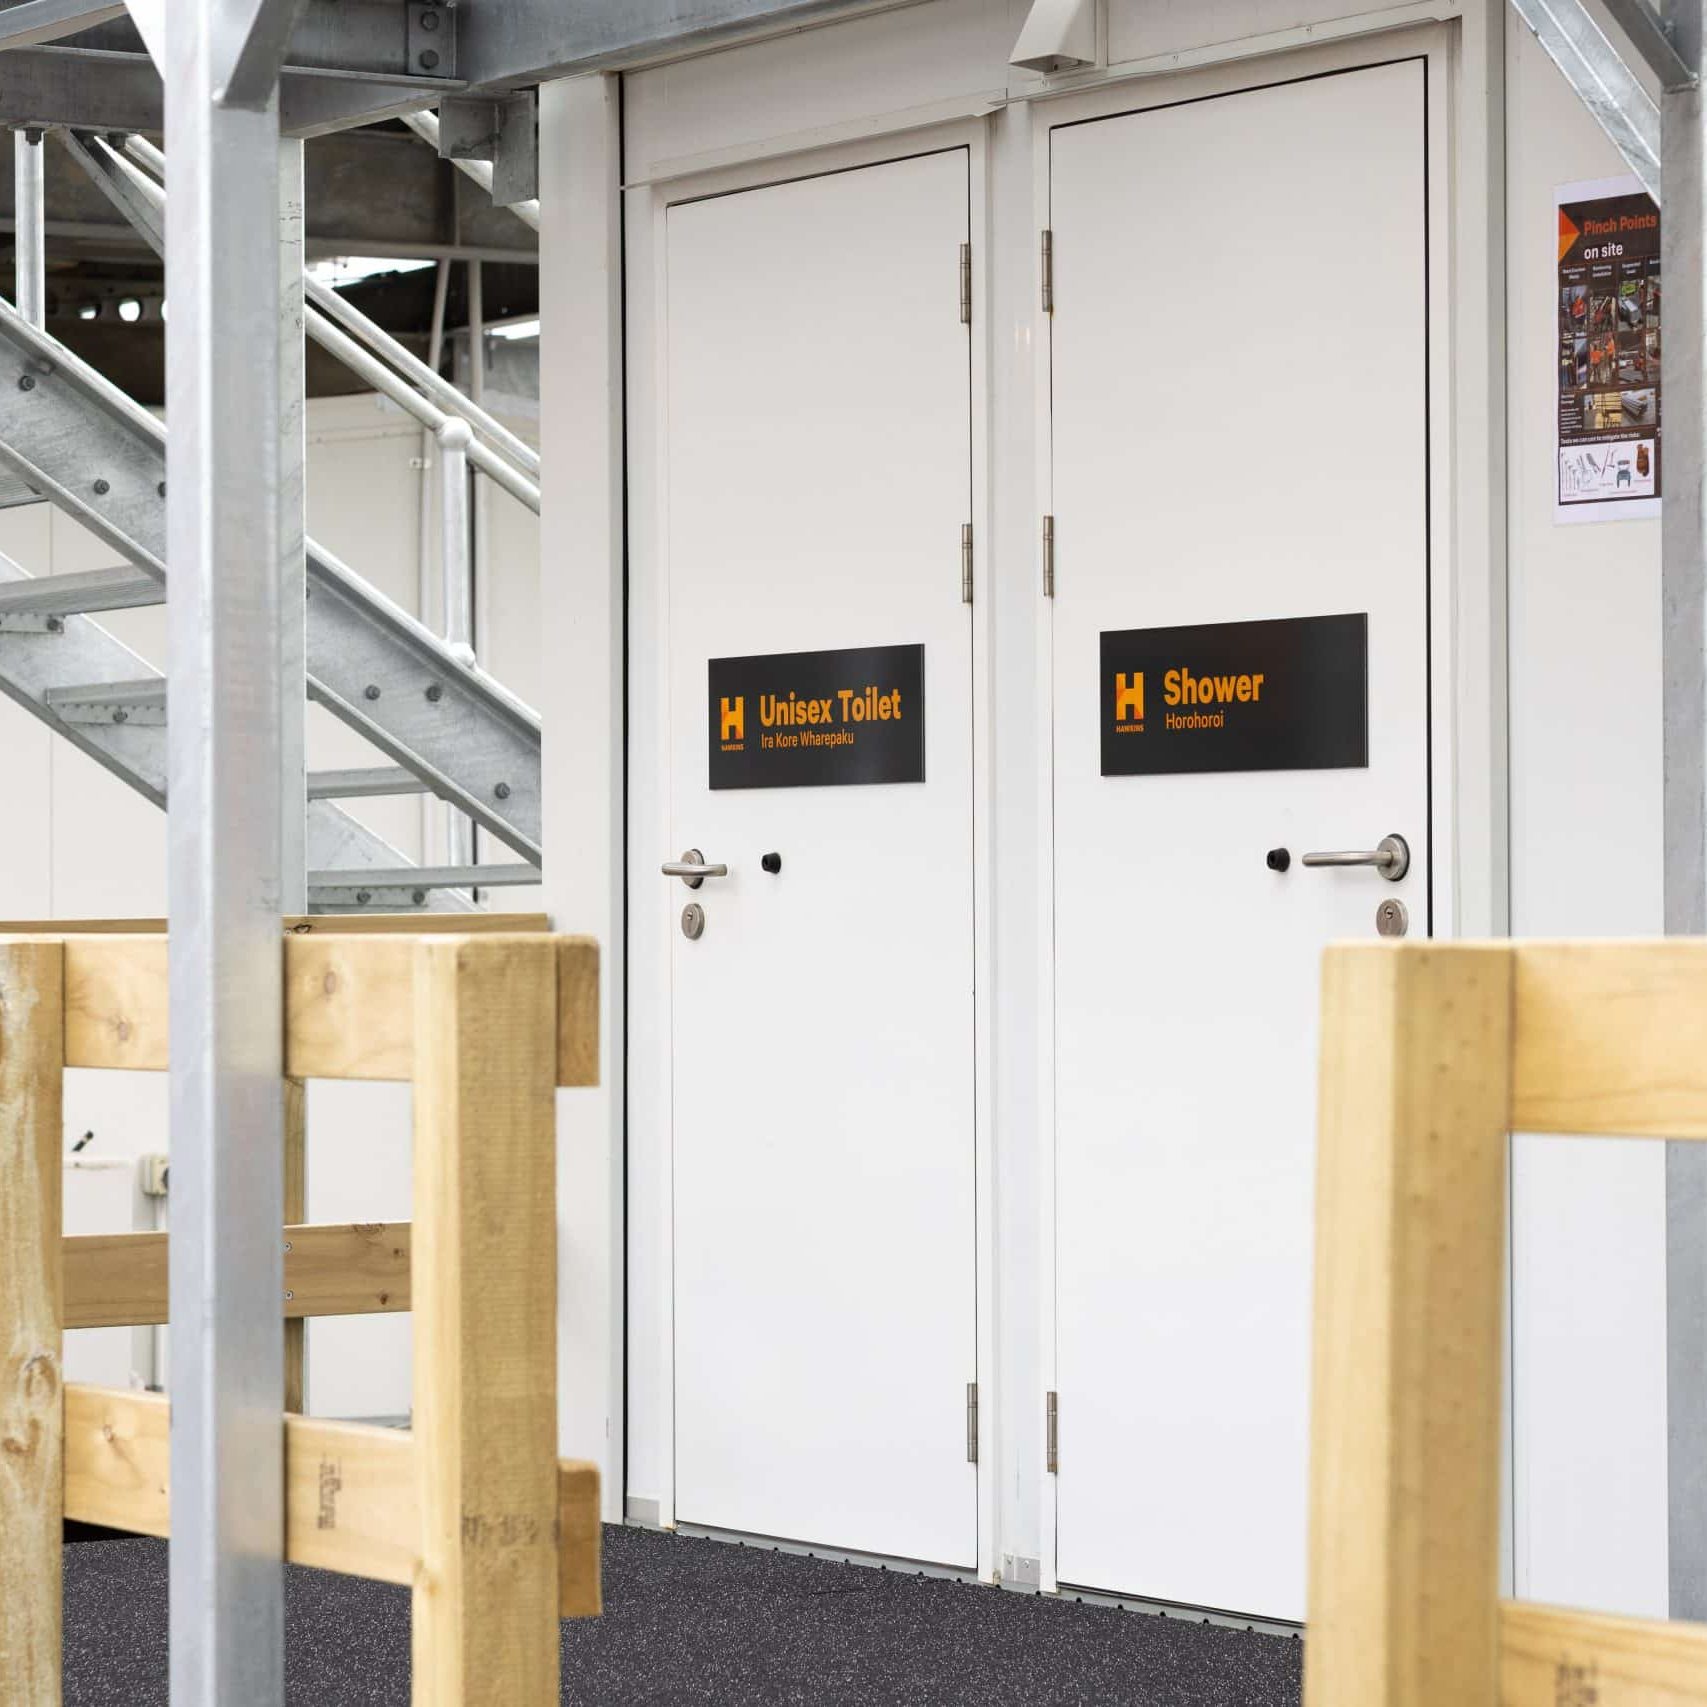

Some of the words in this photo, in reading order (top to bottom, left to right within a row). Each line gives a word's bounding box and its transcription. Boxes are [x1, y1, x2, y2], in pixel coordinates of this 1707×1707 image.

[1583, 218, 1617, 235] Pinch
[1620, 215, 1657, 231] Points
[1584, 247, 1599, 260] on
[1601, 242, 1623, 258] site
[1116, 672, 1144, 720] H
[1164, 667, 1264, 706] Shower
[720, 696, 744, 740] H
[760, 691, 833, 727] Unisex
[838, 686, 902, 723] Toilet
[1166, 709, 1225, 729] Horohoroi
[761, 733, 774, 749] Ira
[775, 732, 798, 748] Kore
[799, 728, 854, 749] Wharepaku
